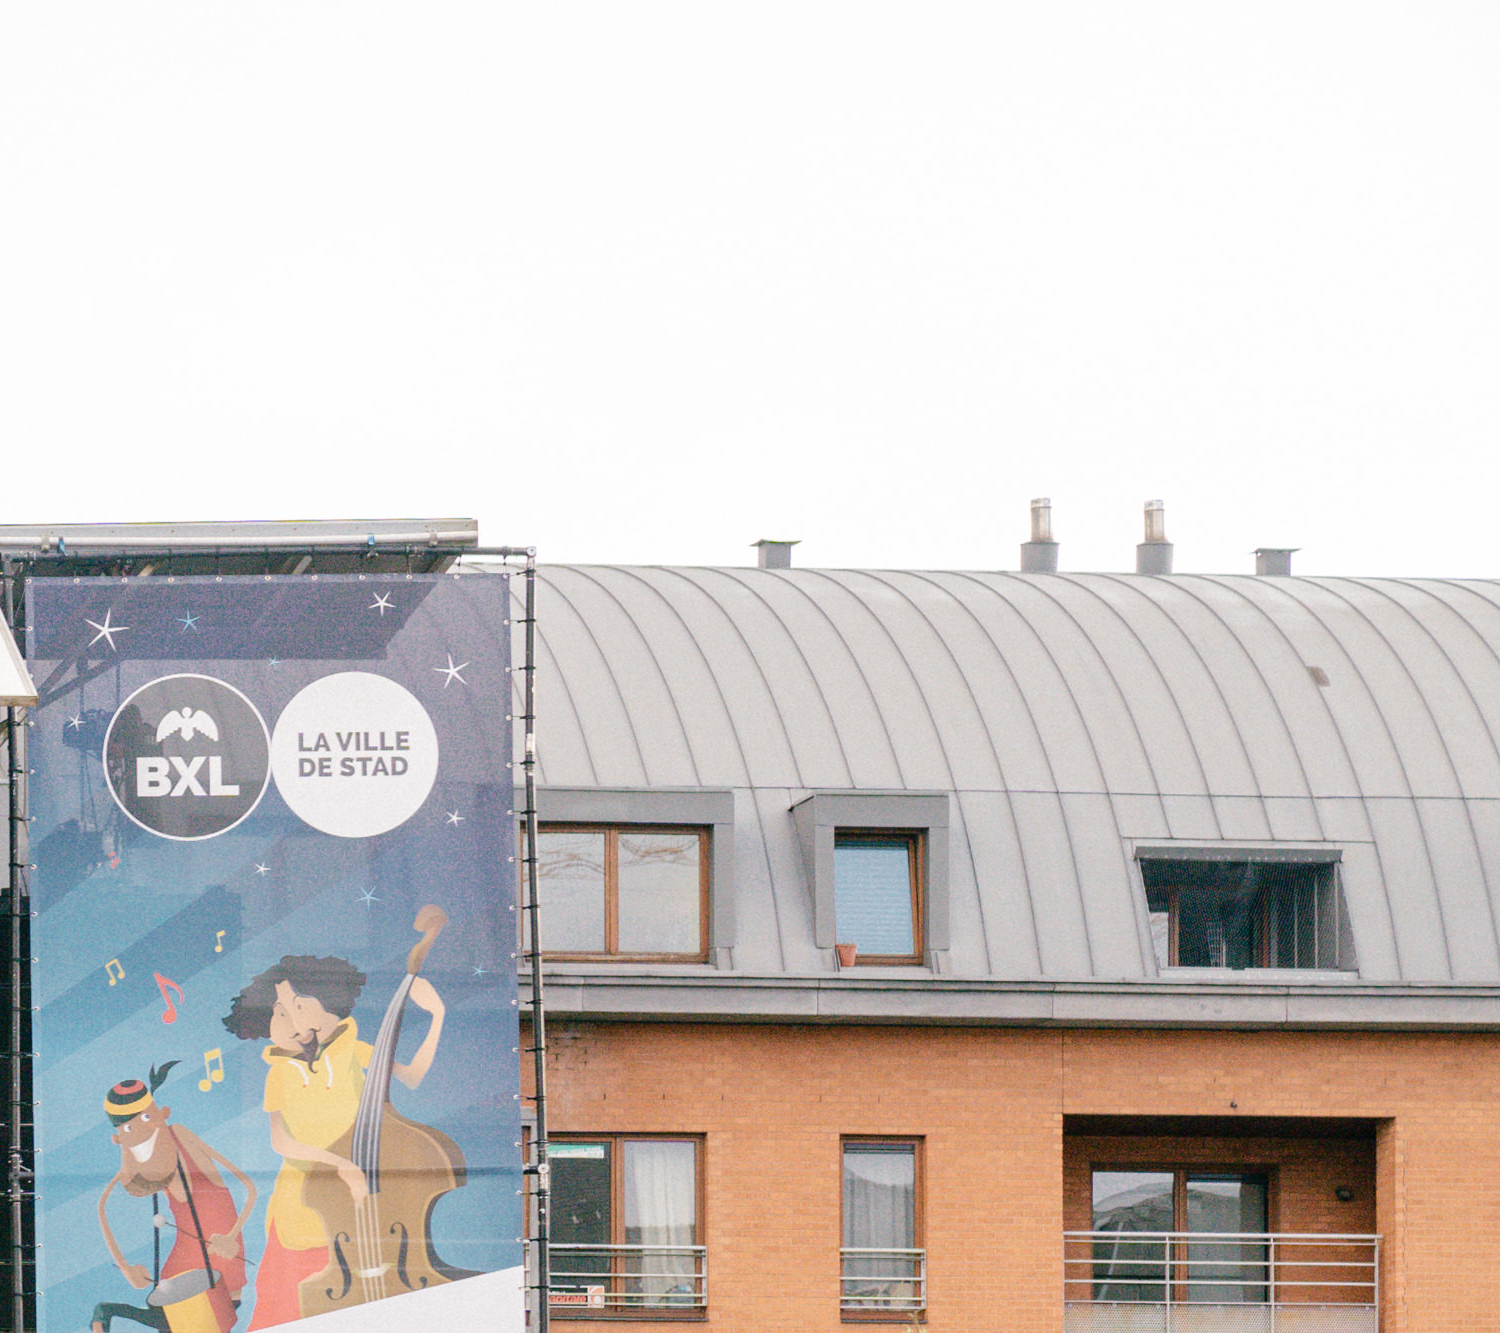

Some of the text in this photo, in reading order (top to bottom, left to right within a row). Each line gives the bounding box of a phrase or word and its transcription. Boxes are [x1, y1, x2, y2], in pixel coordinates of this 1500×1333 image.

[298, 731, 411, 754] LA VILLE
[136, 756, 241, 798] BXL
[298, 757, 410, 779] DE STAD
